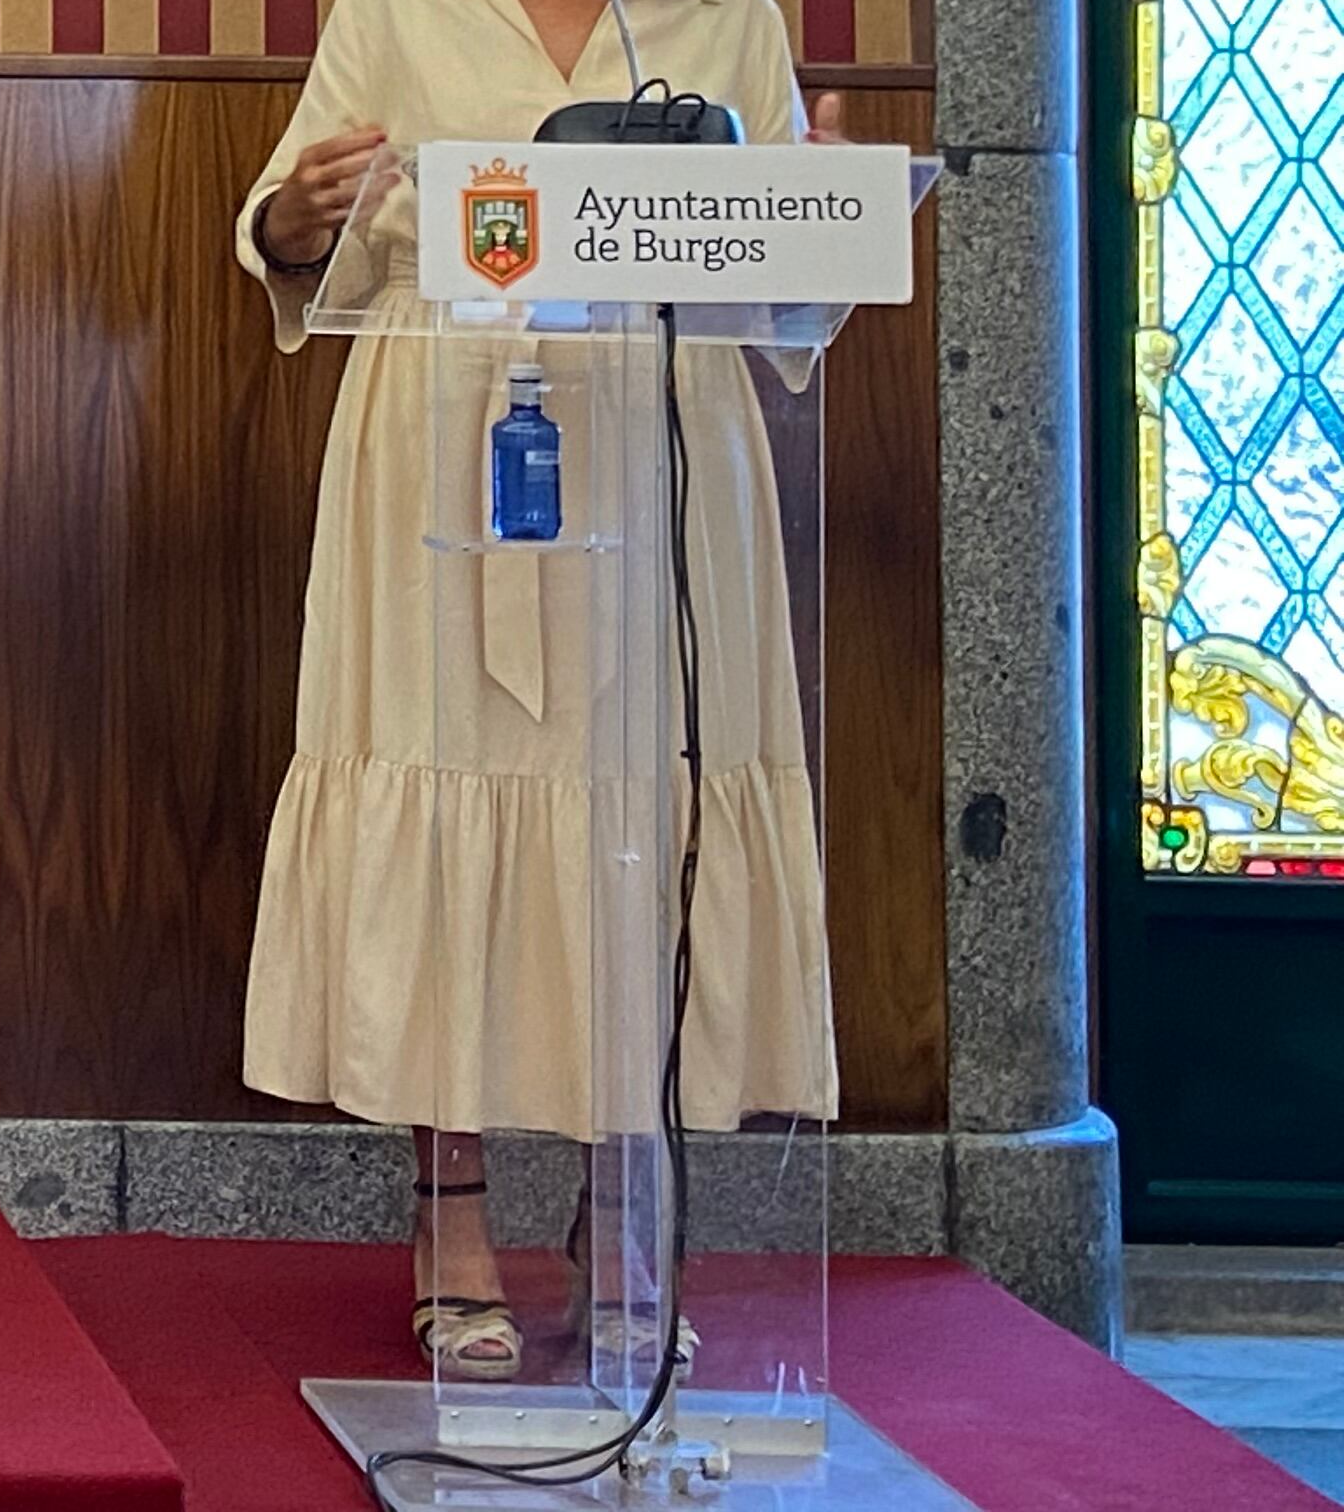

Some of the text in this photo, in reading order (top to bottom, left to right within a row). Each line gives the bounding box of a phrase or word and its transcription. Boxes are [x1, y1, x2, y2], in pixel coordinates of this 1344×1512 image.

[574, 186, 863, 230] Ayuntamiento
[574, 226, 767, 271] de Burgos
